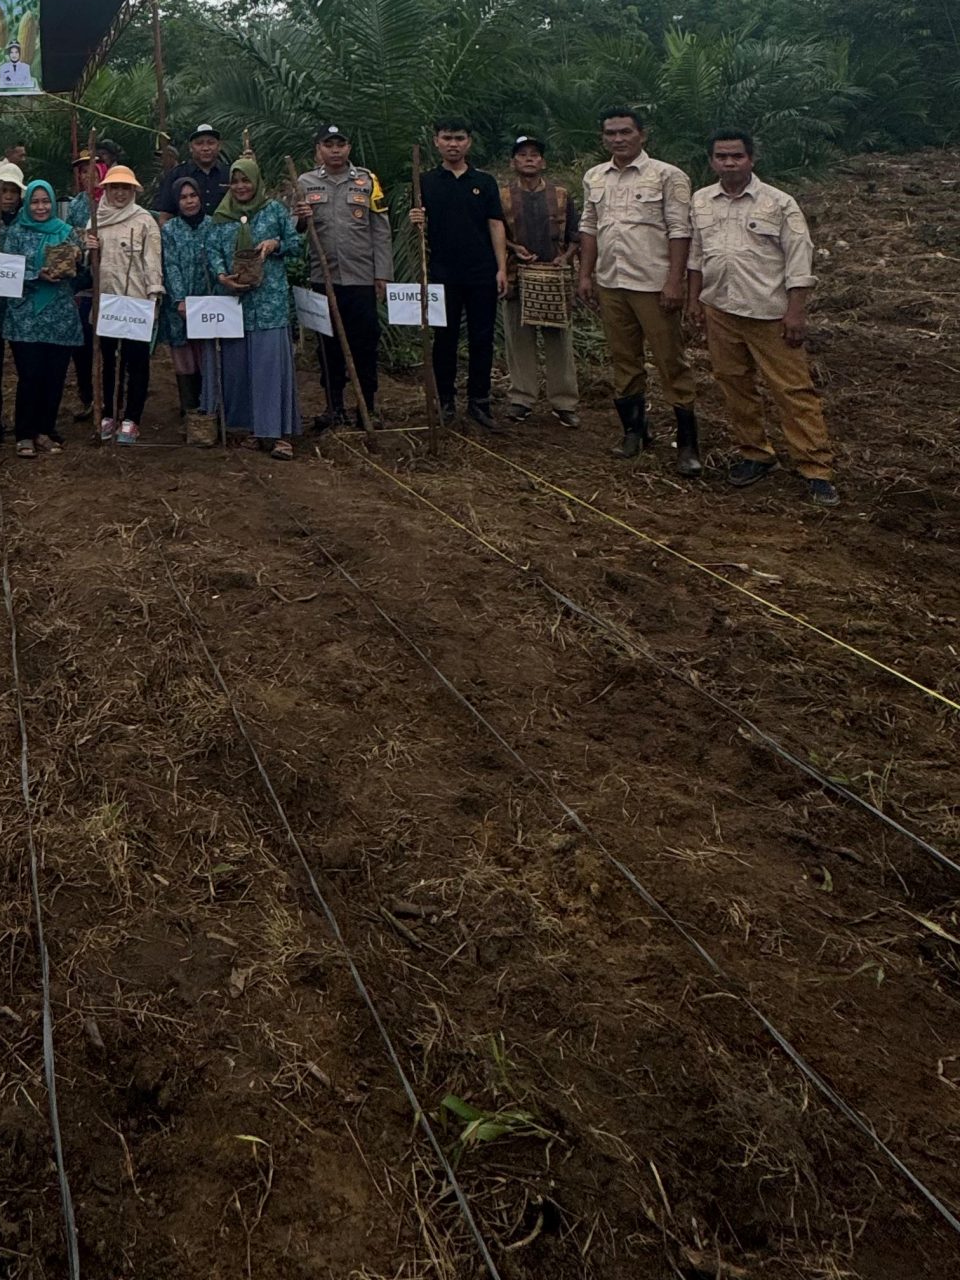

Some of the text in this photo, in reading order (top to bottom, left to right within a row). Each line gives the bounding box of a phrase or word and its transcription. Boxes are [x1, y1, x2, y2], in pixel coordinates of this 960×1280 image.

[101, 313, 147, 324] KEPALA DESA
[201, 312, 225, 323] BPD
